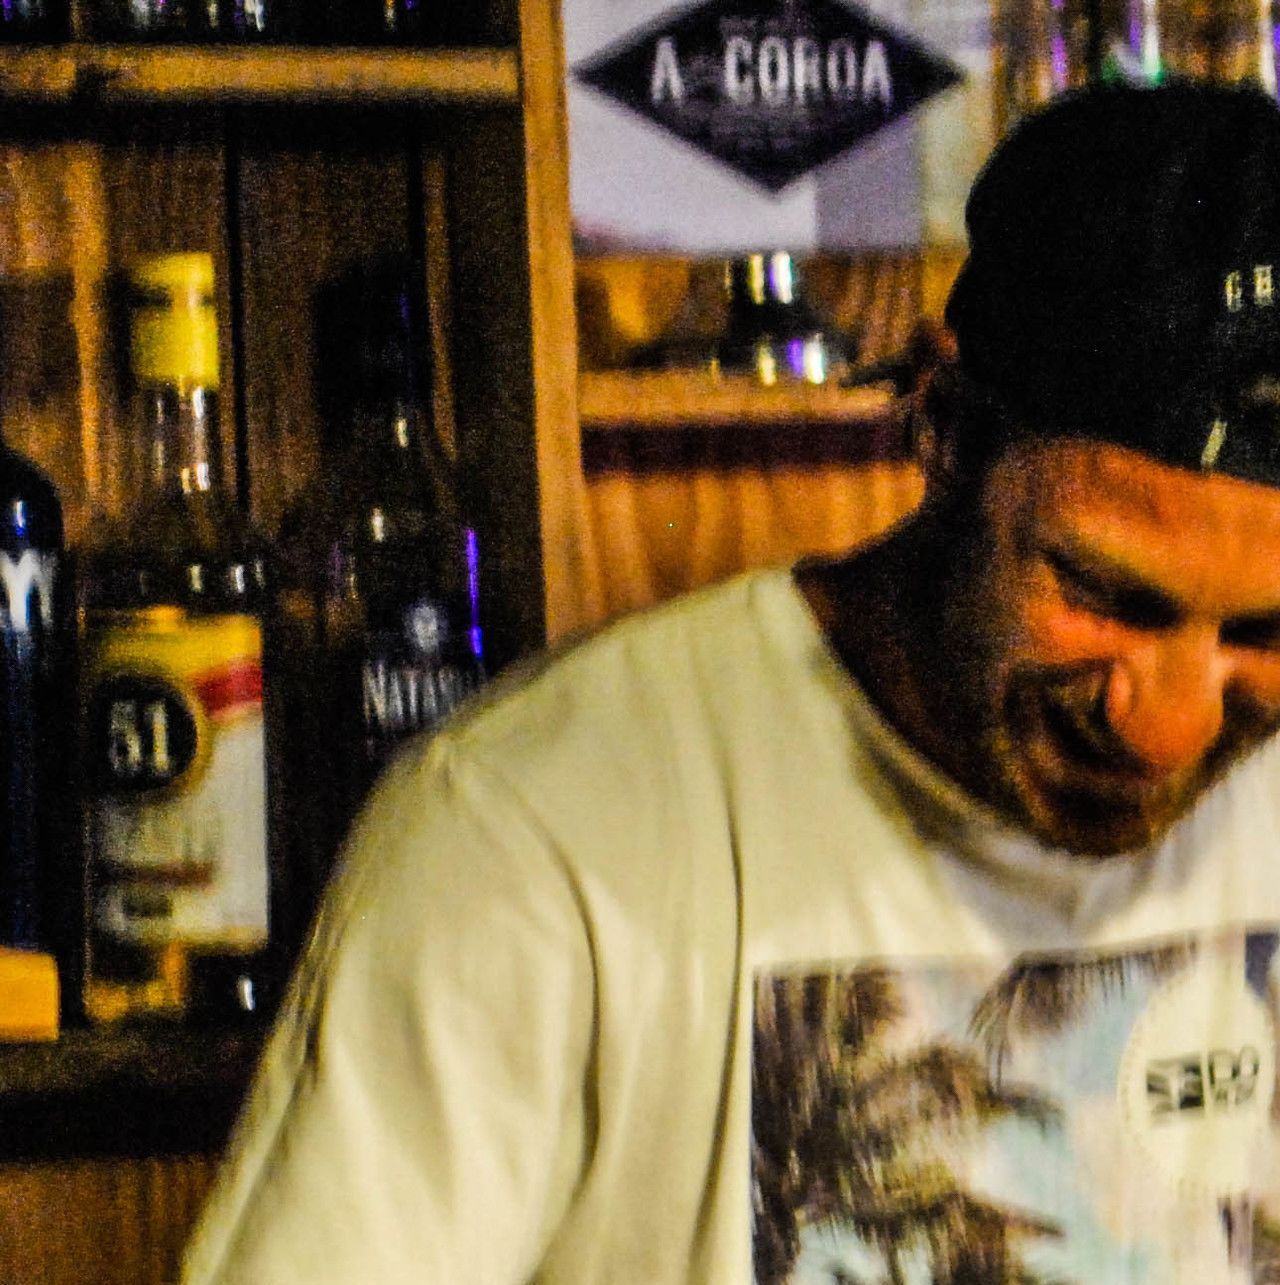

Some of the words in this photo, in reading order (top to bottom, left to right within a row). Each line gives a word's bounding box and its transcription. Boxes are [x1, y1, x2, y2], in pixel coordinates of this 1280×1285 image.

[651, 36, 684, 102] A
[725, 36, 892, 103] COROA
[110, 698, 170, 776] 51
